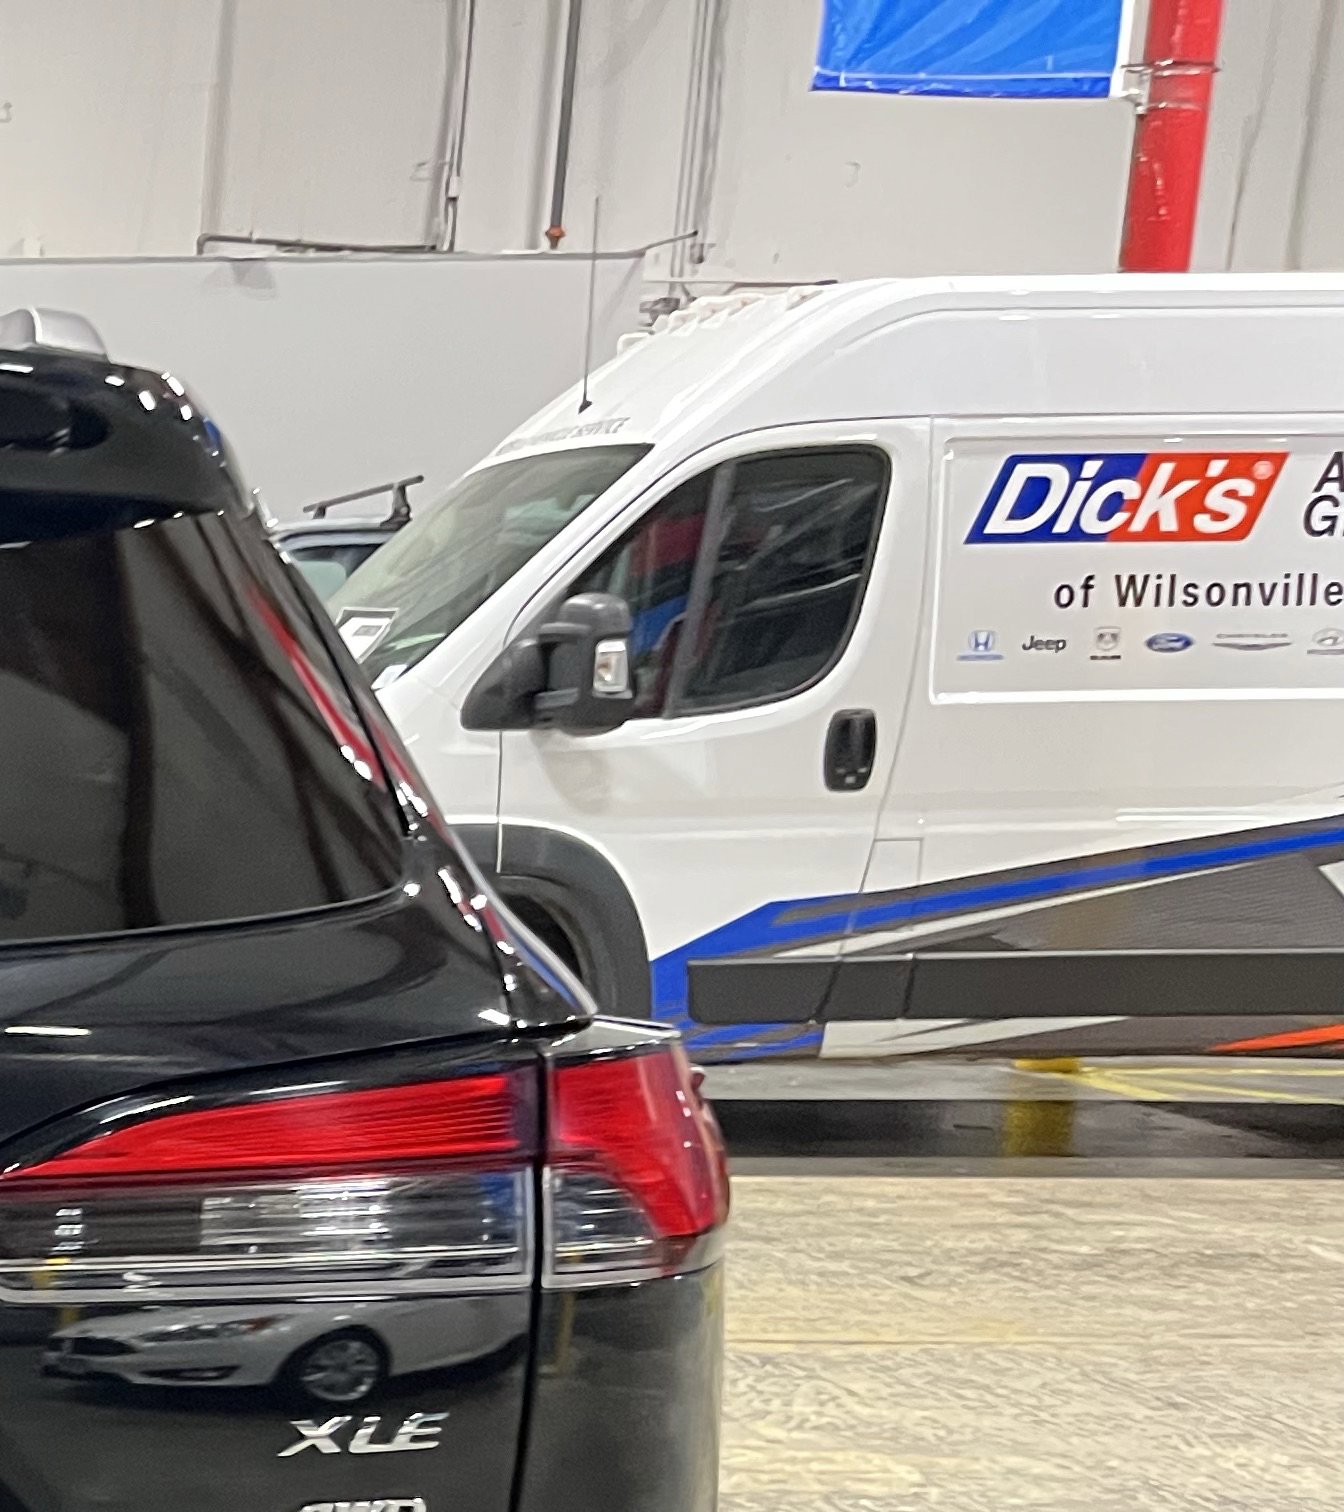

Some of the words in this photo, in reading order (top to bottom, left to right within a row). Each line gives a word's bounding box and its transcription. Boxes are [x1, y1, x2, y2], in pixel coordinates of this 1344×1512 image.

[1054, 574, 1096, 608] of
[1115, 573, 1344, 607] Wilsonville
[1022, 635, 1066, 652] Jeep
[276, 1412, 450, 1457] XLE
